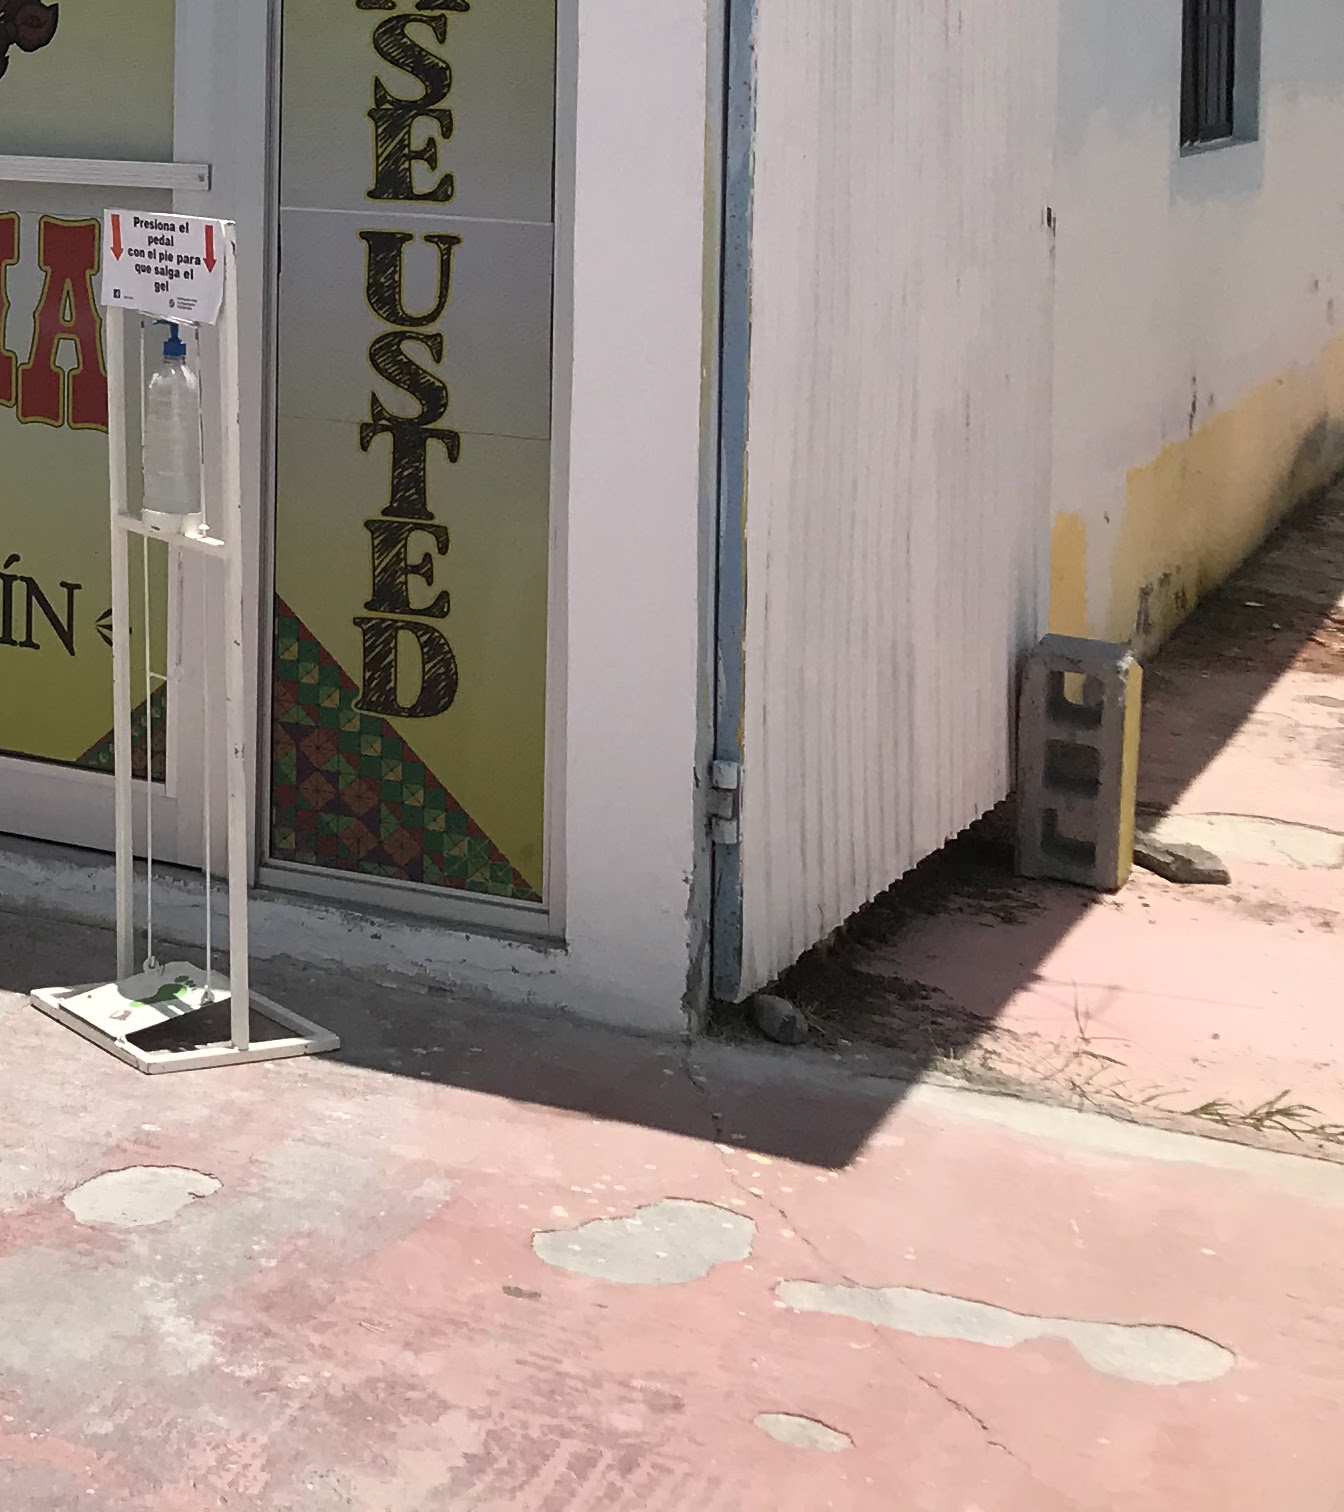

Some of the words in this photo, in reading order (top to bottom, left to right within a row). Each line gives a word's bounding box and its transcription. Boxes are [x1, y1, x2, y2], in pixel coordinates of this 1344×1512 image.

[133, 216, 175, 232] Presiona
[178, 221, 189, 233] el
[147, 235, 174, 247] pedal
[127, 247, 145, 258] con
[147, 248, 156, 260] el
[159, 251, 173, 263] pie
[177, 254, 201, 266] para
[135, 262, 152, 275] que
[154, 265, 180, 280] salga
[183, 269, 194, 280] el
[154, 280, 169, 293] gel
[351, 229, 463, 719] USTED
